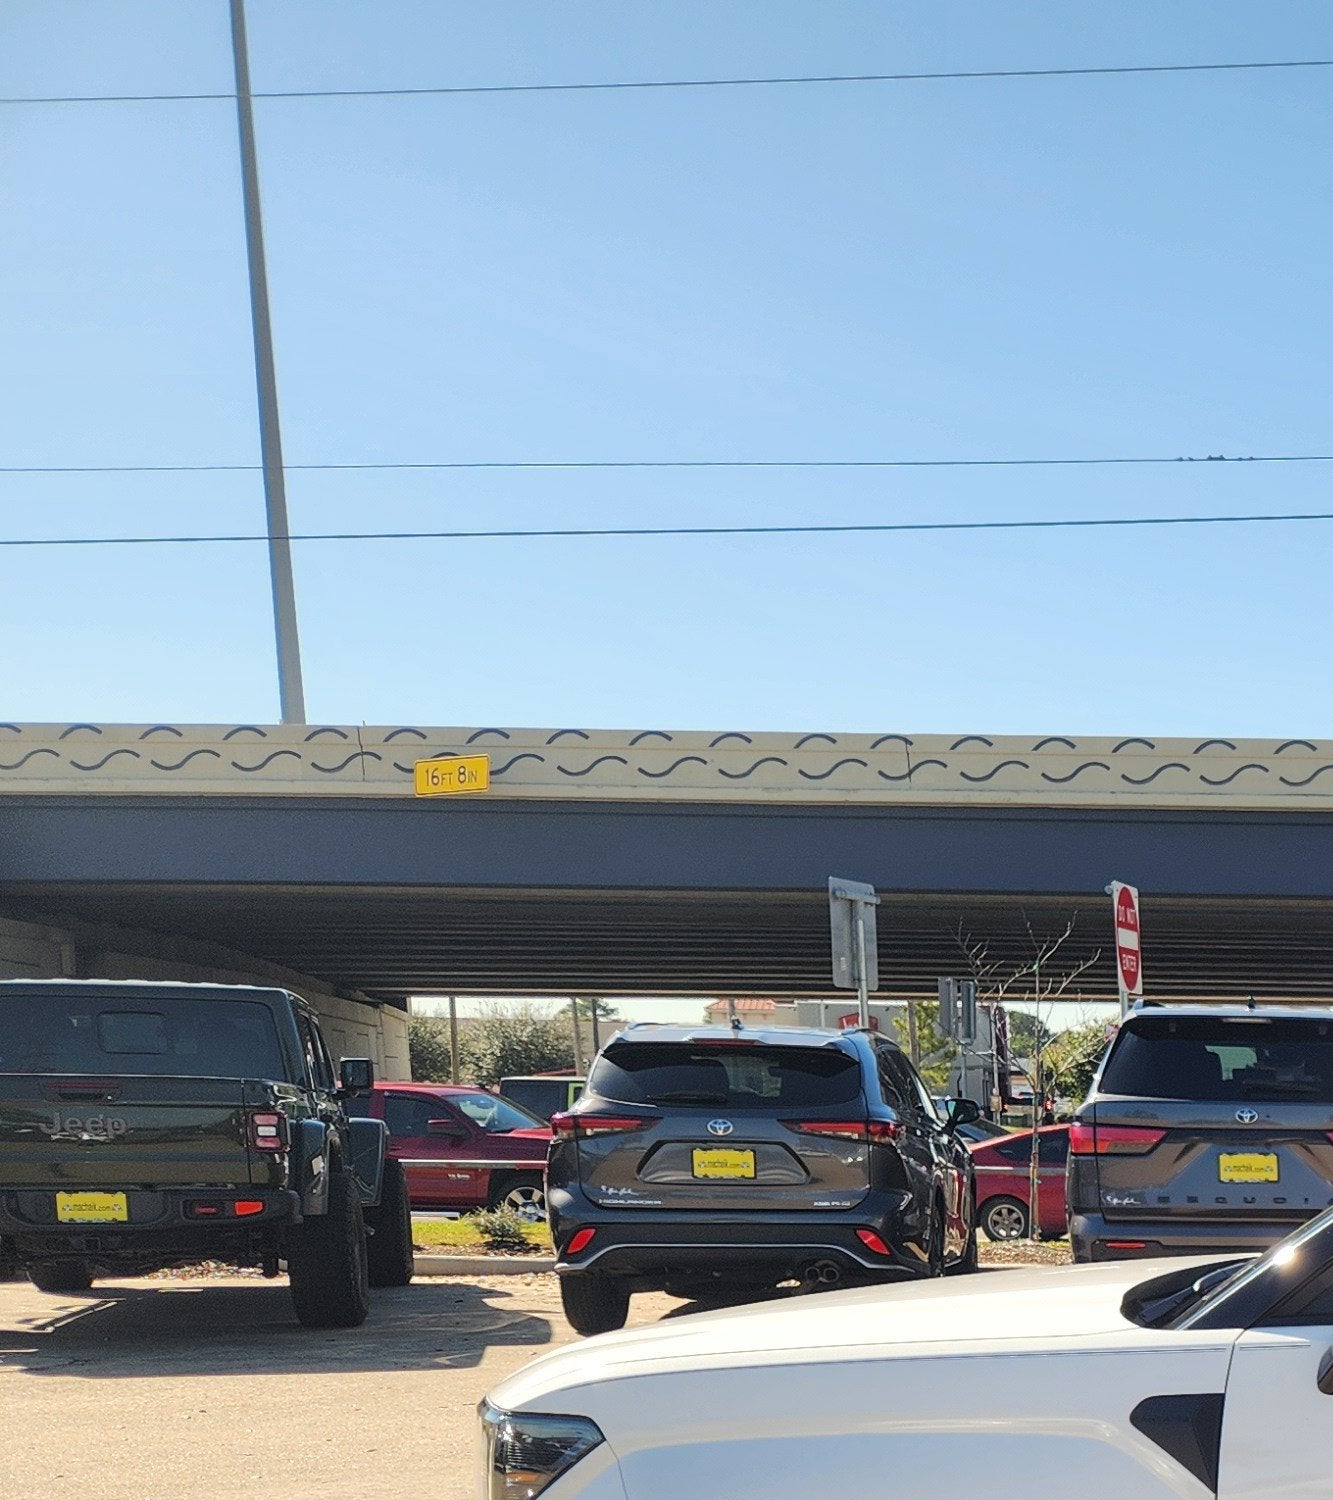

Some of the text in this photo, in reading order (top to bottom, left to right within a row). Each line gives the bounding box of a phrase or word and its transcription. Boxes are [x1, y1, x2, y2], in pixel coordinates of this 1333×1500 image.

[1118, 905, 1136, 925] DO NOT
[1122, 953, 1137, 972] ENTER
[38, 1112, 127, 1139] Jeep
